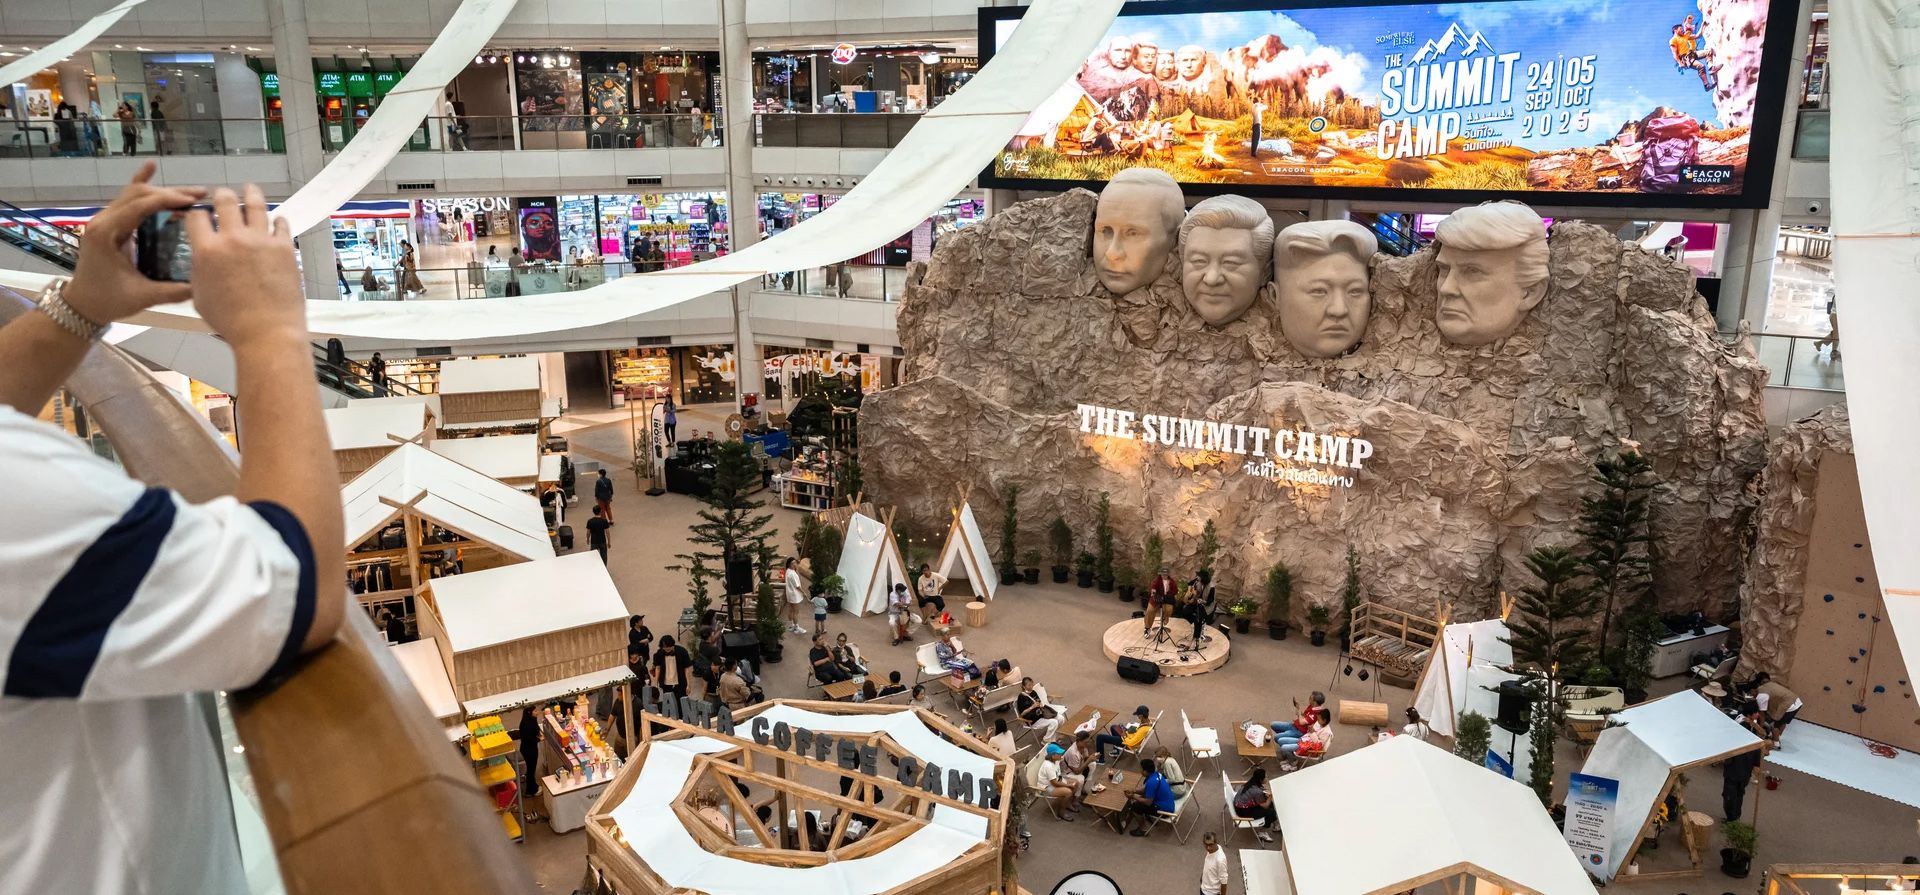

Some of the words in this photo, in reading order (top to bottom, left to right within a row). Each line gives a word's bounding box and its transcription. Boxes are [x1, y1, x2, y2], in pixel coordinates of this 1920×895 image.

[836, 48, 854, 58] DQ
[1384, 53, 1403, 69] THE
[1380, 52, 1521, 117] SUMMIT
[1526, 60, 1555, 92] 24
[1566, 54, 1598, 86] 05
[1525, 90, 1553, 112] SEP
[1563, 86, 1594, 107] OCT
[1376, 111, 1461, 161] CAMP
[422, 196, 511, 214] SEASON
[1077, 403, 1135, 440] THE
[1142, 413, 1270, 458] SUMMIT
[1274, 429, 1374, 470] CAMP
[642, 686, 736, 736] LANTA
[751, 716, 878, 777] COFFEE
[896, 755, 998, 809] CAMP
